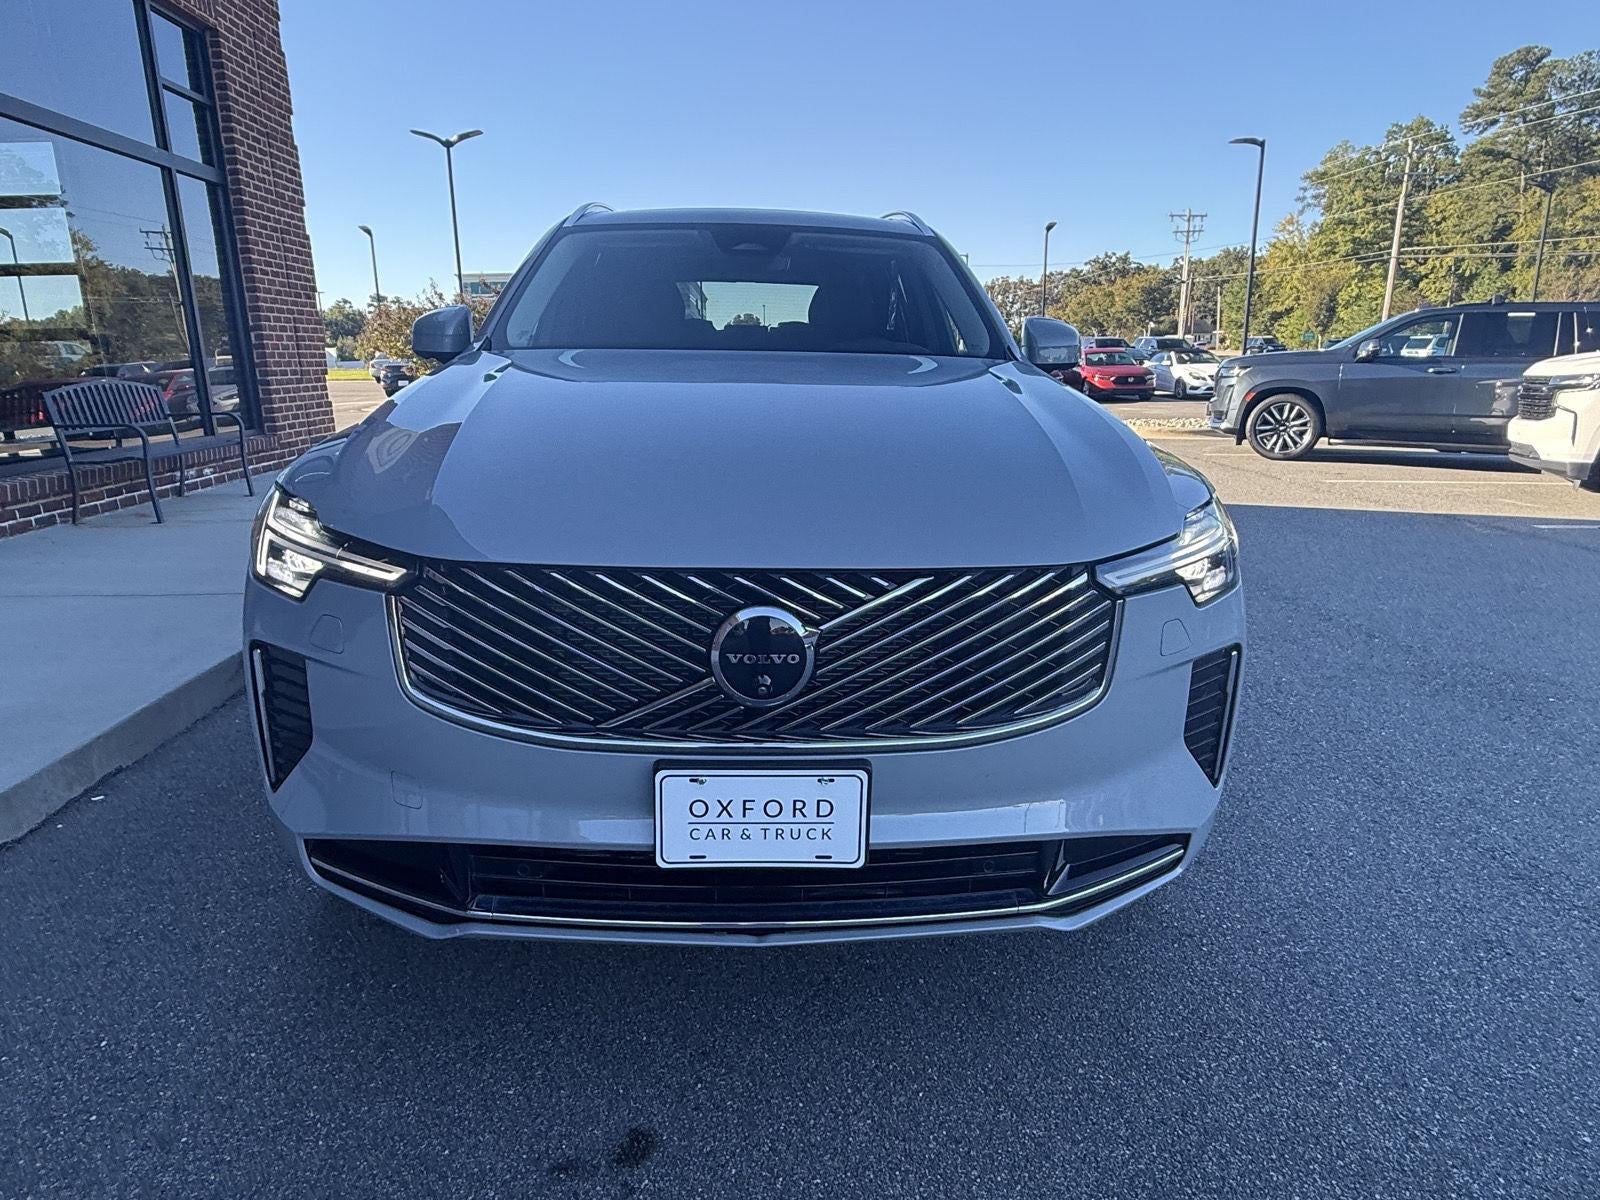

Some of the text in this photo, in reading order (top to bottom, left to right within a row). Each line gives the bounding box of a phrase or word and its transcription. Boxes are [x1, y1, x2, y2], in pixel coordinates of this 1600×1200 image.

[726, 653, 801, 665] VOLVO
[688, 799, 834, 819] OXFORD
[689, 828, 832, 841] CAR & TRUCK
